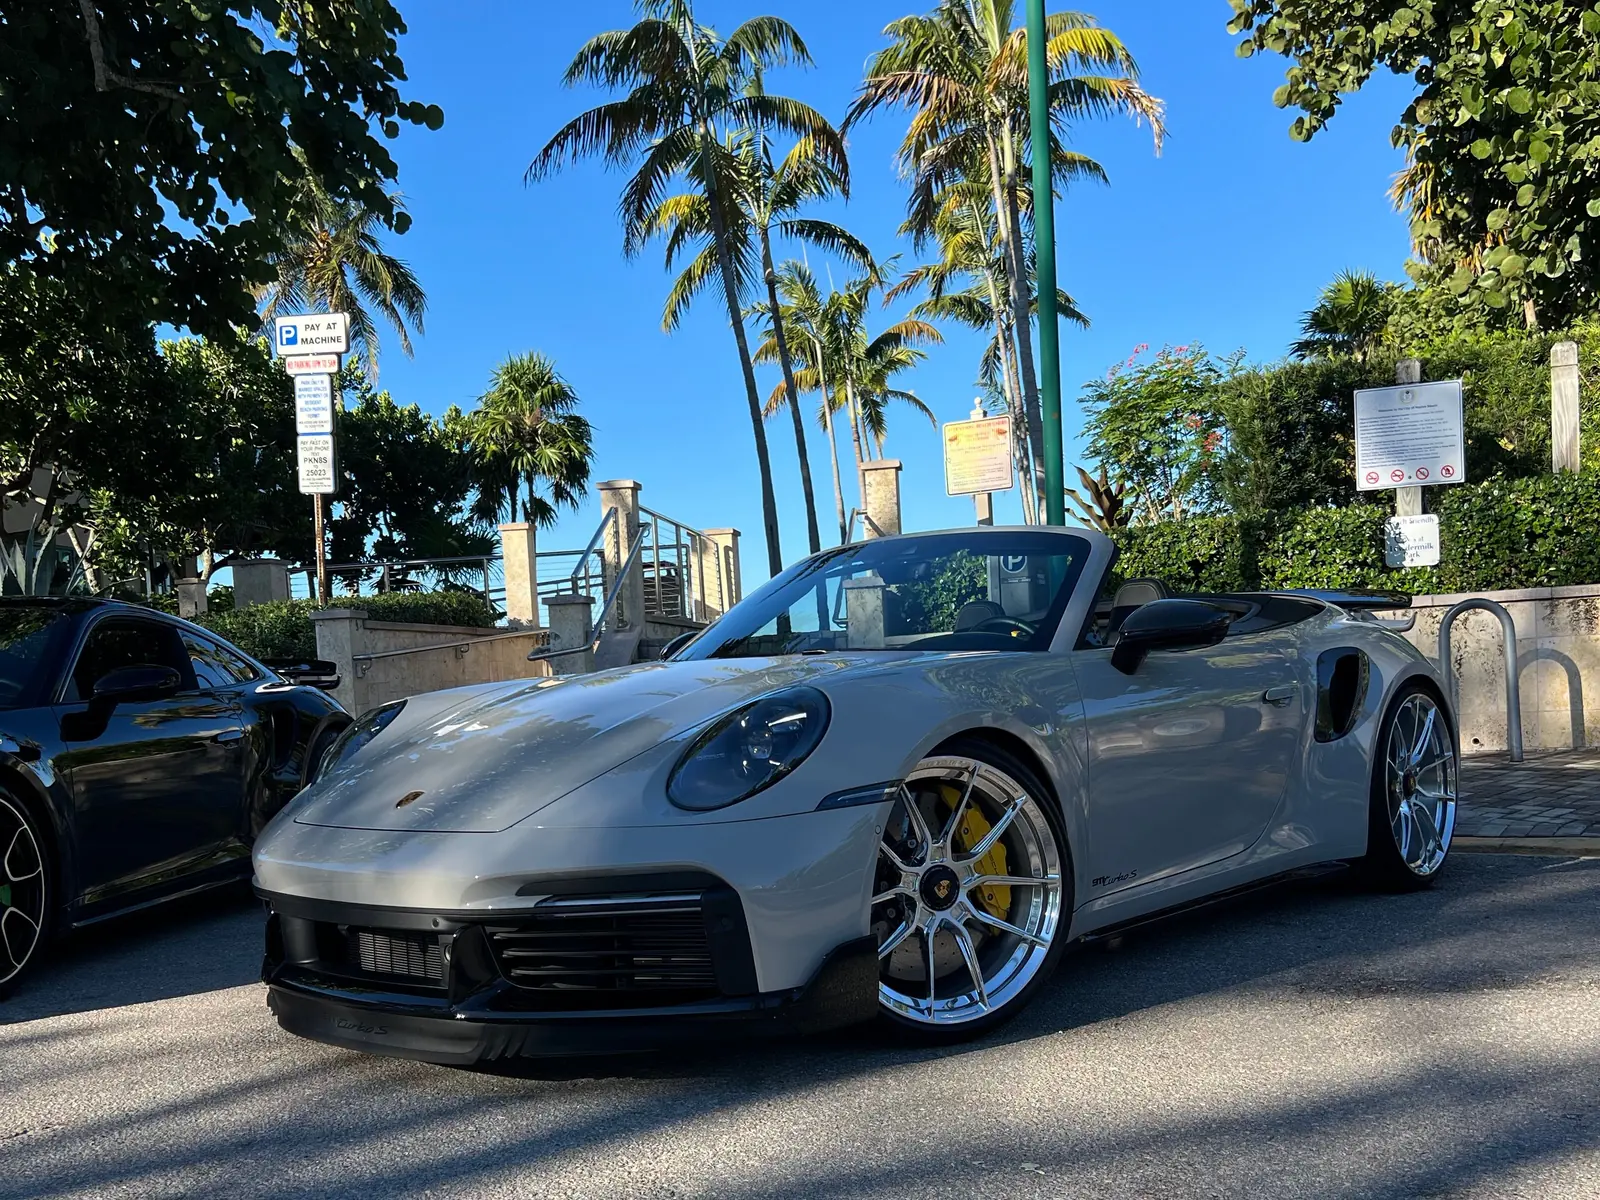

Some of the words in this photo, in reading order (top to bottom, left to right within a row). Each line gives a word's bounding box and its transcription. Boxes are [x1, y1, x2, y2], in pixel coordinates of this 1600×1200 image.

[304, 323, 321, 332] PAY
[326, 322, 337, 330] AT
[300, 335, 342, 345] MACHINE
[287, 361, 294, 369] NO
[294, 360, 311, 369] PARKING
[322, 360, 327, 368] TO
[374, 1025, 389, 1034] S
